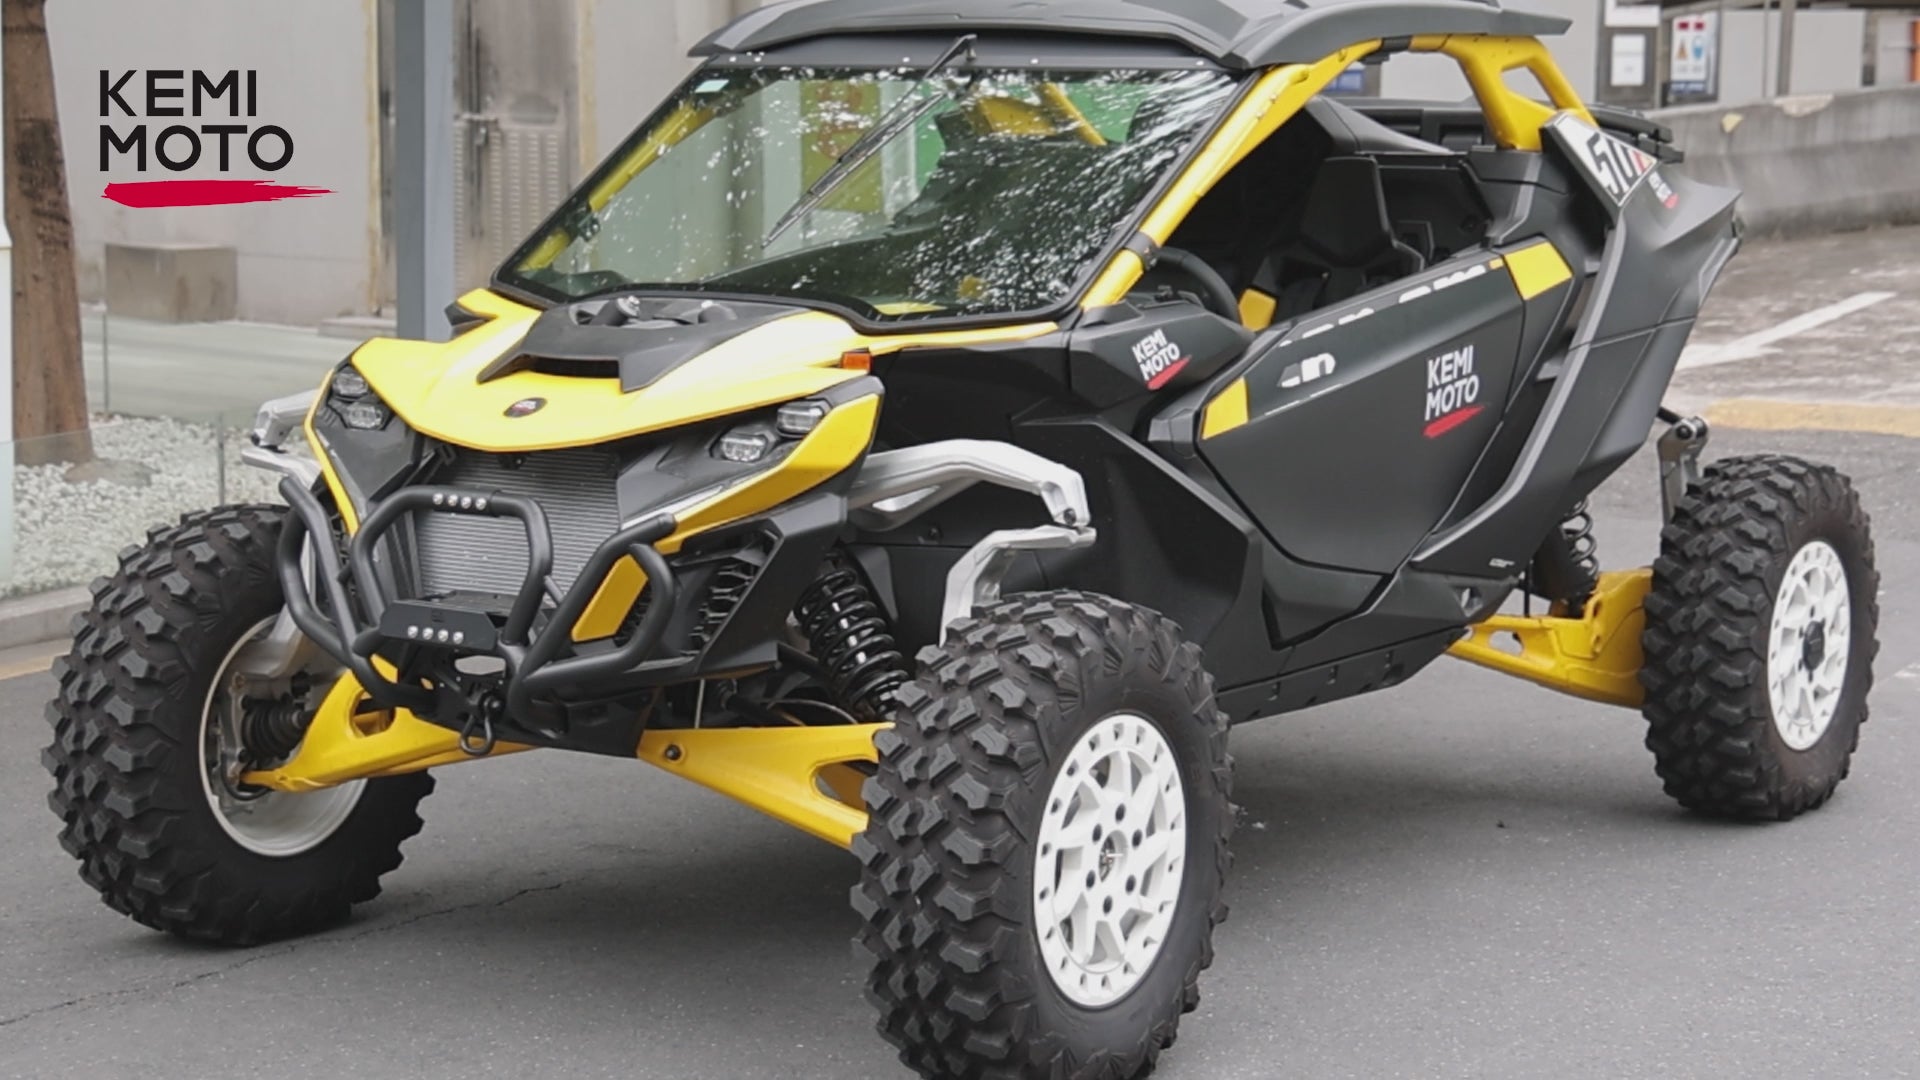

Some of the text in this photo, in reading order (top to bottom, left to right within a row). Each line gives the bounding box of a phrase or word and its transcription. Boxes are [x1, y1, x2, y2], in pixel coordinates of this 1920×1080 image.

[1132, 328, 1168, 363] KEMI
[1140, 342, 1180, 381] MOTO
[1427, 344, 1474, 389] KEMI
[1424, 374, 1479, 421] MOTO
